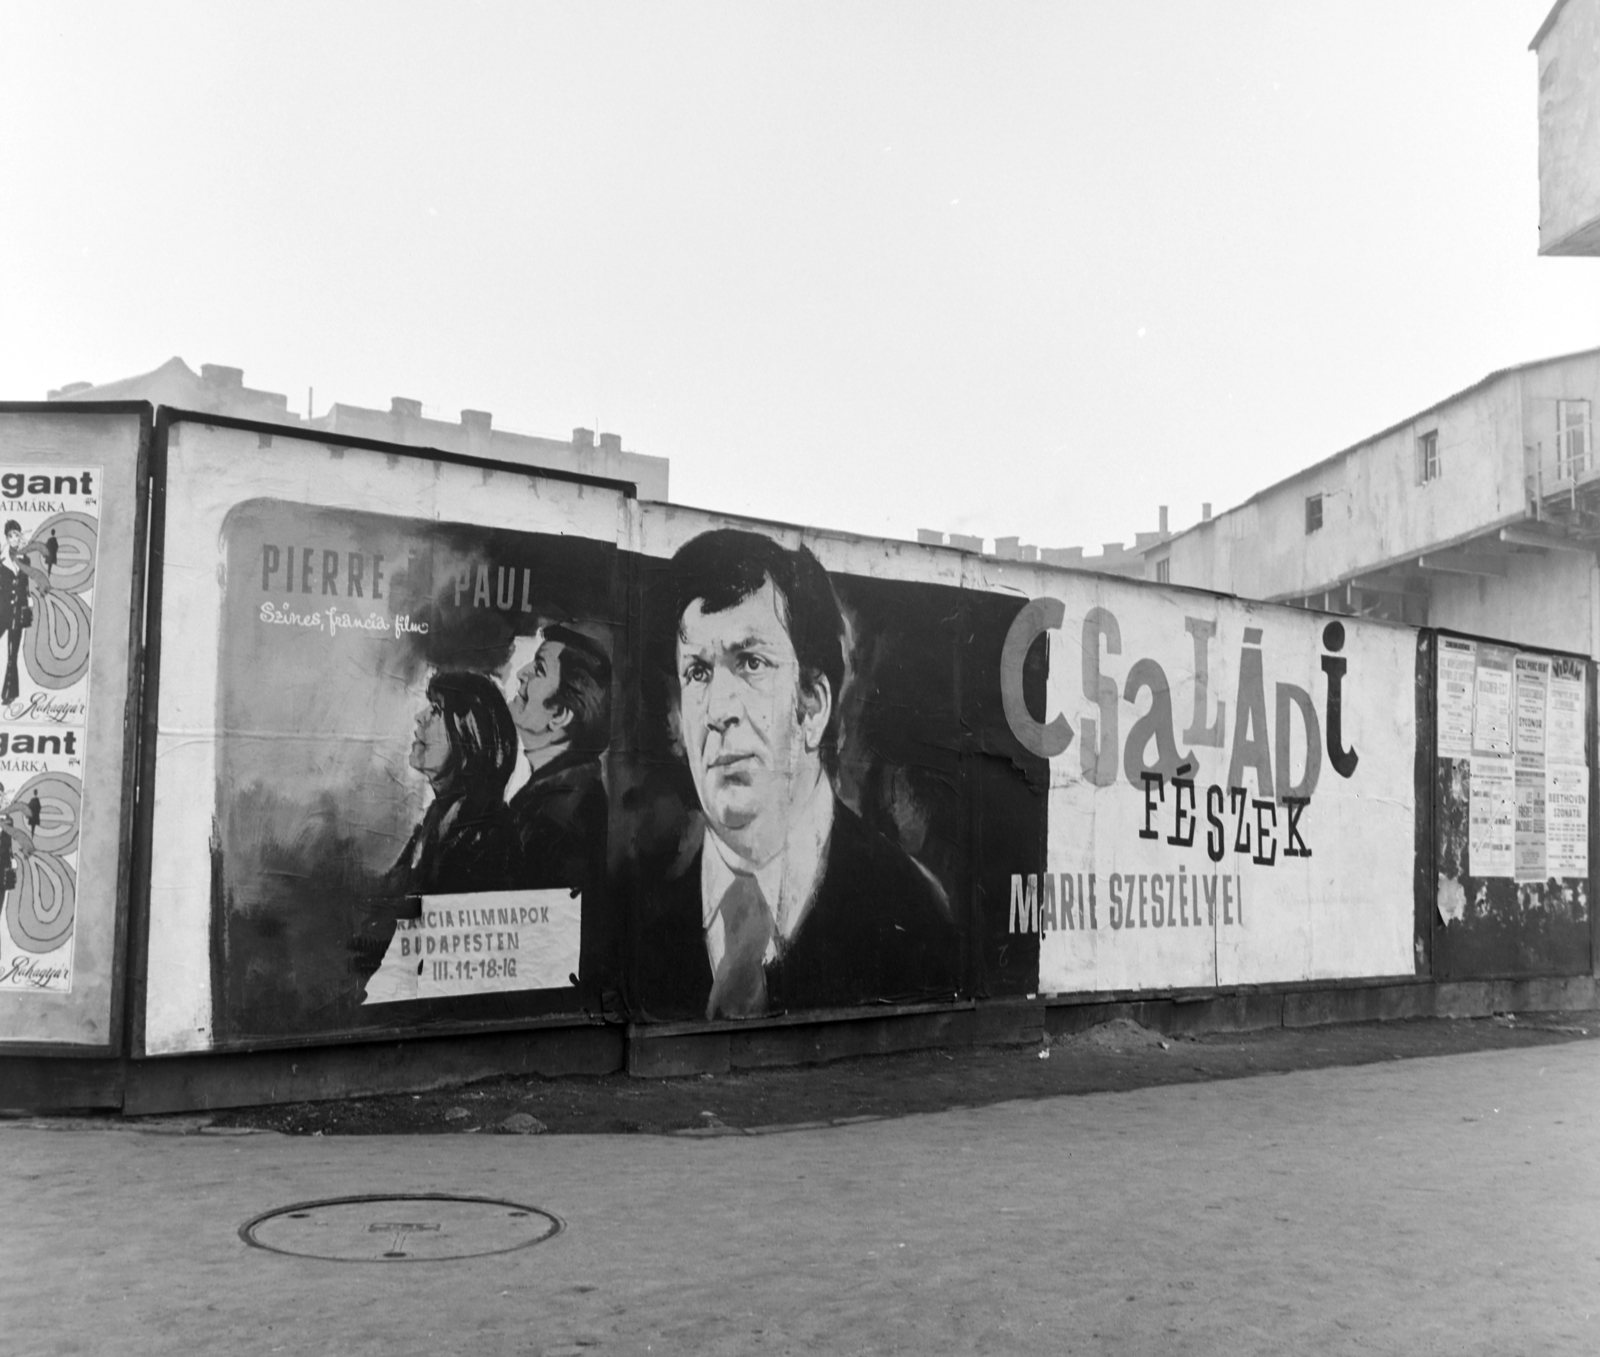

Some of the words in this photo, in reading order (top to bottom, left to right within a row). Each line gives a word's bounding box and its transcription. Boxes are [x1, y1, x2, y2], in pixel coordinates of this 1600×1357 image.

[1, 471, 93, 499] gant
[262, 543, 384, 599] PIERRE
[455, 564, 532, 613] PAUL
[326, 606, 390, 637] francia
[395, 614, 429, 639] film
[1139, 763, 1312, 866] FÉSZEK
[1009, 872, 1097, 934] MARIE
[1109, 864, 1242, 931] SZESZÉLYEI
[401, 932, 519, 957] BUDAPESTEN
